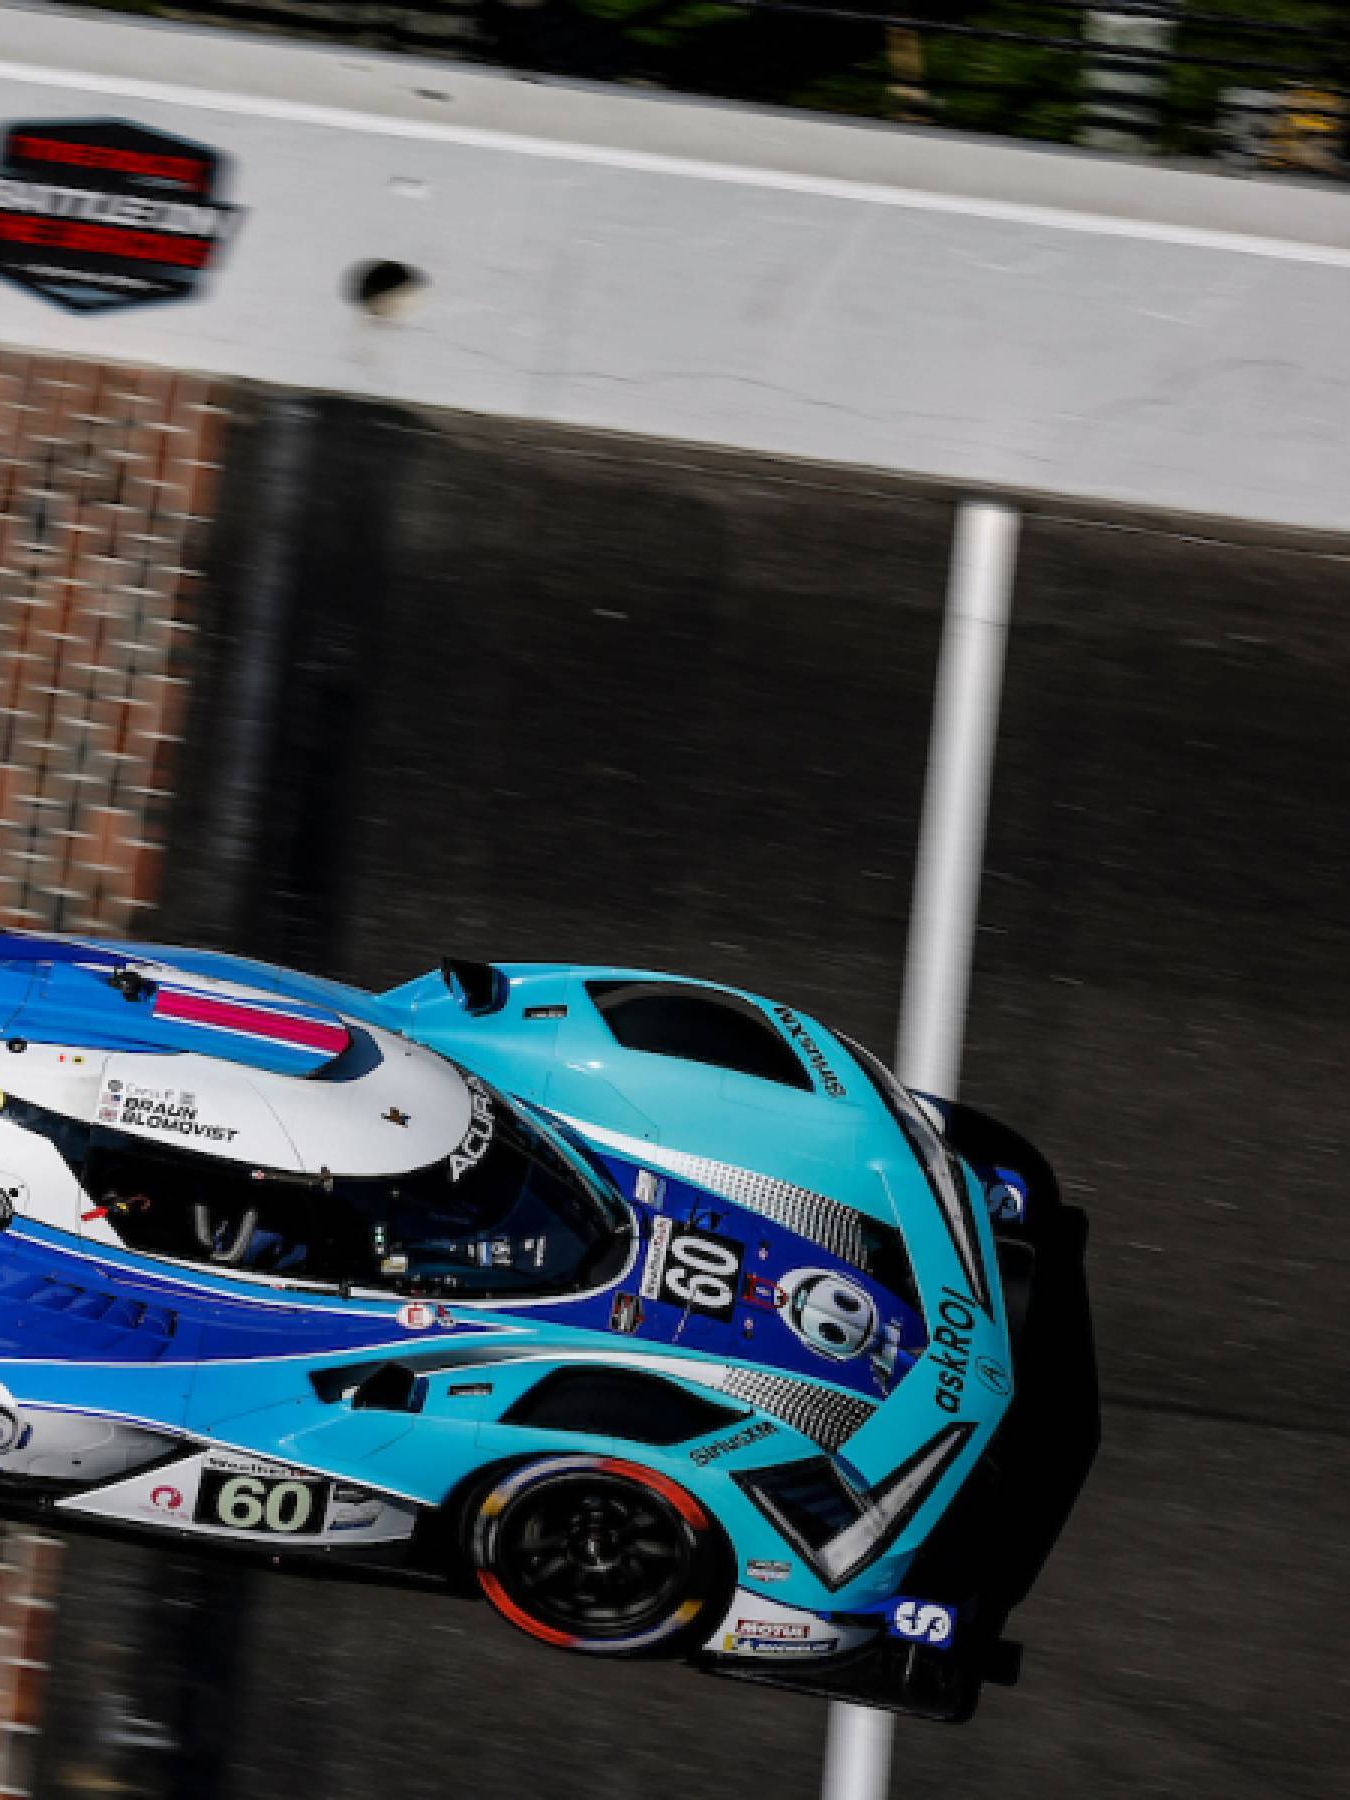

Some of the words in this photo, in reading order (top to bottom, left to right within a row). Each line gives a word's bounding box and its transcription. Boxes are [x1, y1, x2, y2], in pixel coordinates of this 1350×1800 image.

[120, 1109, 241, 1143] BLOMQVIST
[125, 1097, 199, 1121] BRAUN
[665, 1236, 739, 1308] 60
[929, 1286, 977, 1414] askROI
[690, 1422, 778, 1467] SiriusXM
[218, 1475, 313, 1531] 60
